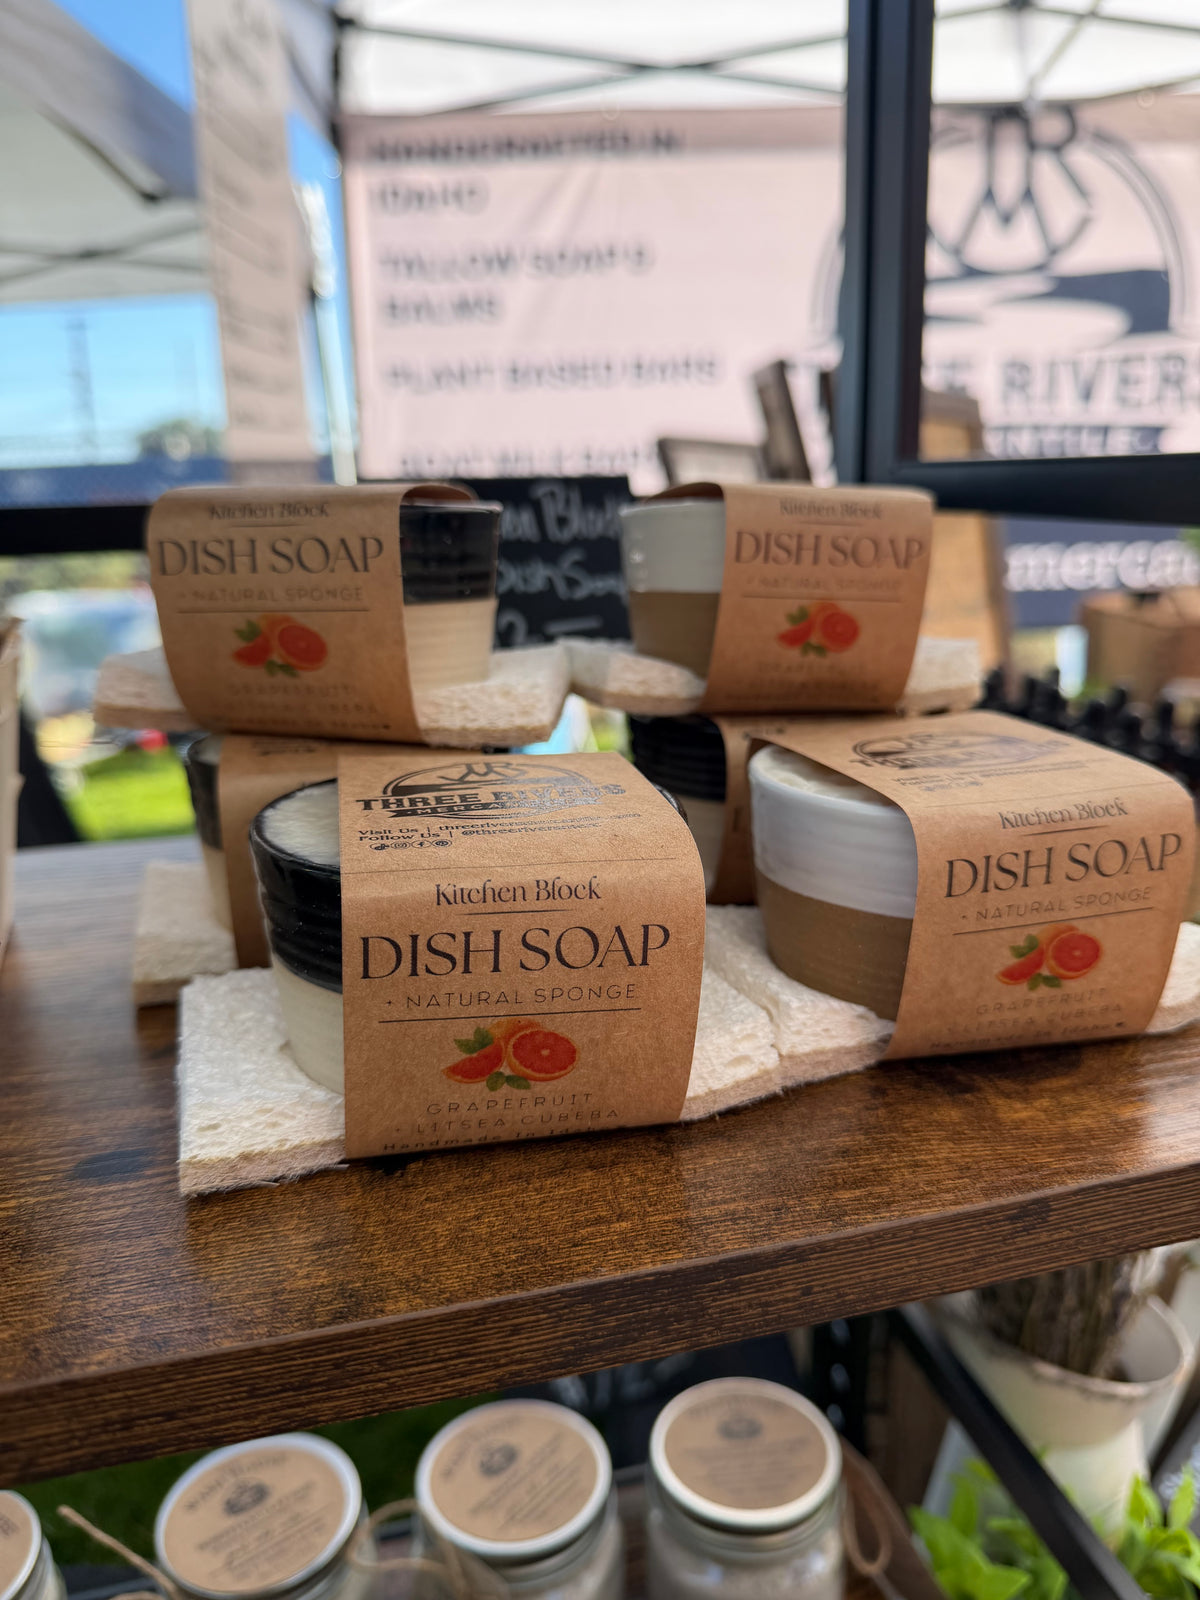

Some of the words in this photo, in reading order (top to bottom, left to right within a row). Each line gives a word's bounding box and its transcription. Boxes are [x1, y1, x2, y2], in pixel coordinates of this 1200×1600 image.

[1003, 355, 1200, 412] RIVER
[209, 503, 274, 520] Kitchen
[279, 501, 330, 519] Block
[779, 499, 837, 517] Kitchen
[840, 502, 883, 519] Block
[158, 538, 258, 576] DISH
[270, 536, 384, 574] SOAP
[735, 531, 821, 566] DISH
[828, 536, 924, 570] SOAP
[191, 588, 278, 603] NATURAL
[286, 587, 364, 602] SPONGE
[355, 793, 482, 811] THREE
[492, 784, 626, 801] RIVERS
[1000, 804, 1073, 830] Kitchen
[1075, 797, 1128, 821] Block
[359, 834, 415, 842] Follow
[944, 847, 1053, 898] DISH
[1065, 833, 1182, 882] SOAP
[435, 879, 527, 906] Kitchen
[535, 875, 602, 902] Block
[975, 901, 1066, 922] NATURAL
[1073, 886, 1152, 910] SPONGE
[359, 929, 504, 980] DISH
[519, 923, 671, 972] SOAP
[407, 989, 524, 1009] NATURAL
[534, 983, 636, 1003] SPONGE
[426, 1092, 593, 1115] GRAPEFRUIT
[416, 1117, 506, 1134] LITSEA
[520, 1109, 619, 1126] CUBEBA
